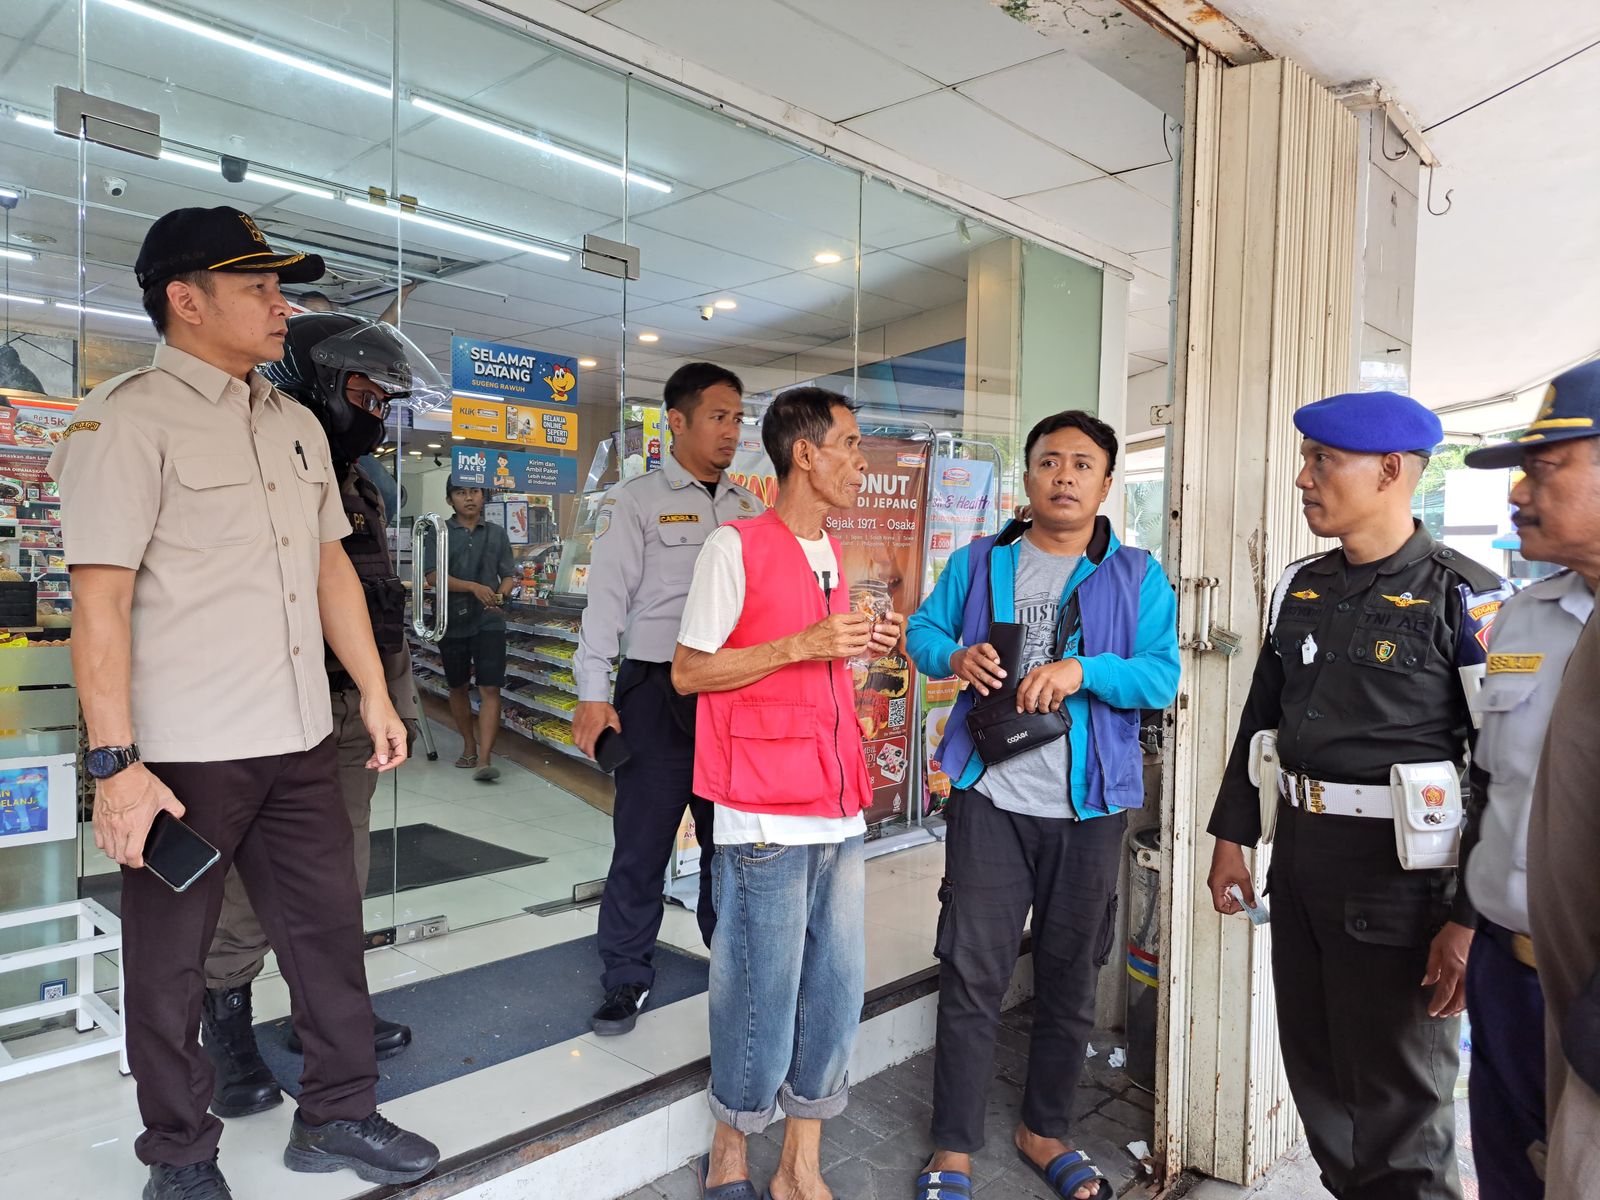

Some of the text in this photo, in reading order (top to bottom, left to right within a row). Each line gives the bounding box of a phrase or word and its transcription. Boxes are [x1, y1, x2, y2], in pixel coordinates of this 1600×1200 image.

[470, 347, 536, 369] SELAMAT
[474, 361, 531, 382] DATANG
[471, 379, 526, 393] SUGENG RAWUH
[44, 416, 65, 426] 15K
[543, 414, 566, 424] BELANJA
[543, 421, 562, 430] ONLINE
[546, 429, 568, 437] SEPERTI
[458, 451, 487, 466] indo
[458, 464, 487, 472] PAKET
[857, 496, 917, 510] DI JEPANG
[826, 516, 854, 531] Sejak
[857, 518, 876, 530] 1971
[887, 518, 916, 531] Osaka
[1364, 612, 1430, 634] TNI AD
